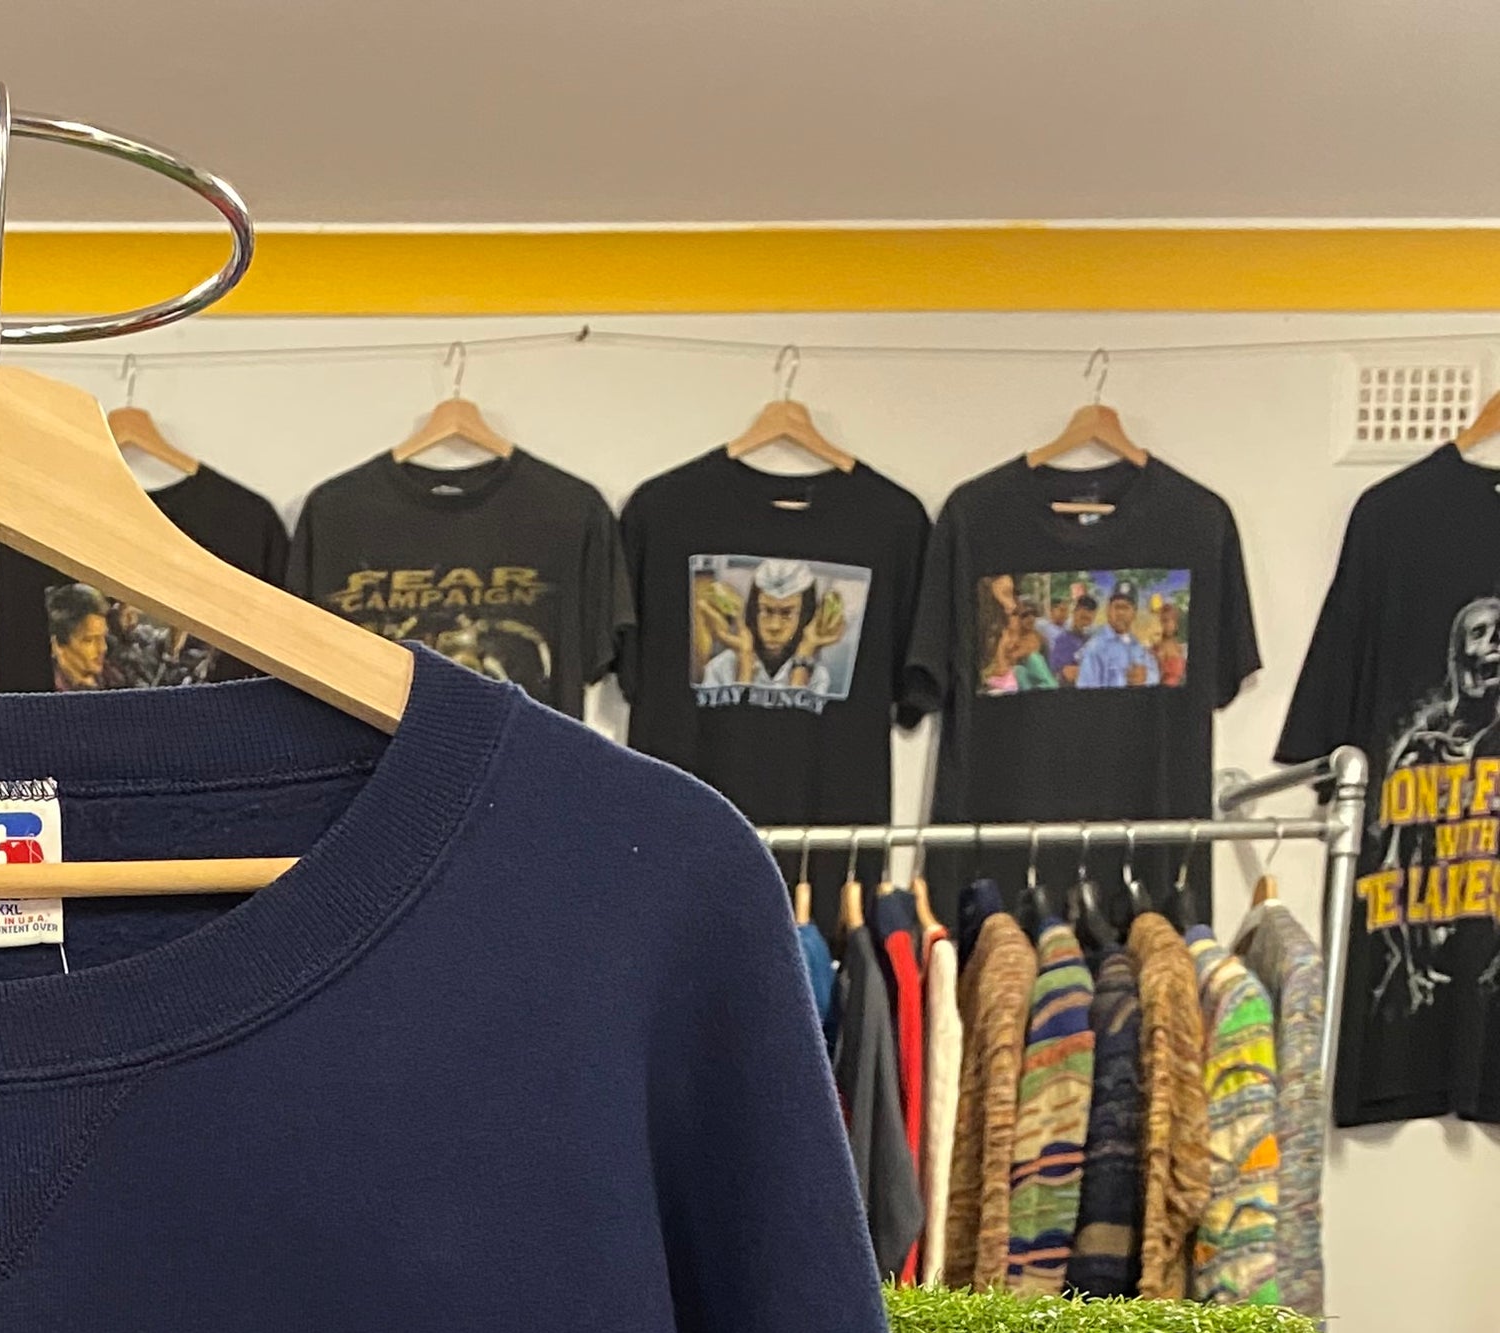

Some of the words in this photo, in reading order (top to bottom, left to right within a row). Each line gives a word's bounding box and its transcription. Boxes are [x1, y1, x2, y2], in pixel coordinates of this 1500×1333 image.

[347, 566, 539, 593] FEAR
[340, 584, 547, 613] CAMPAIGN
[4, 917, 15, 925] IN
[32, 922, 58, 932] OVER
